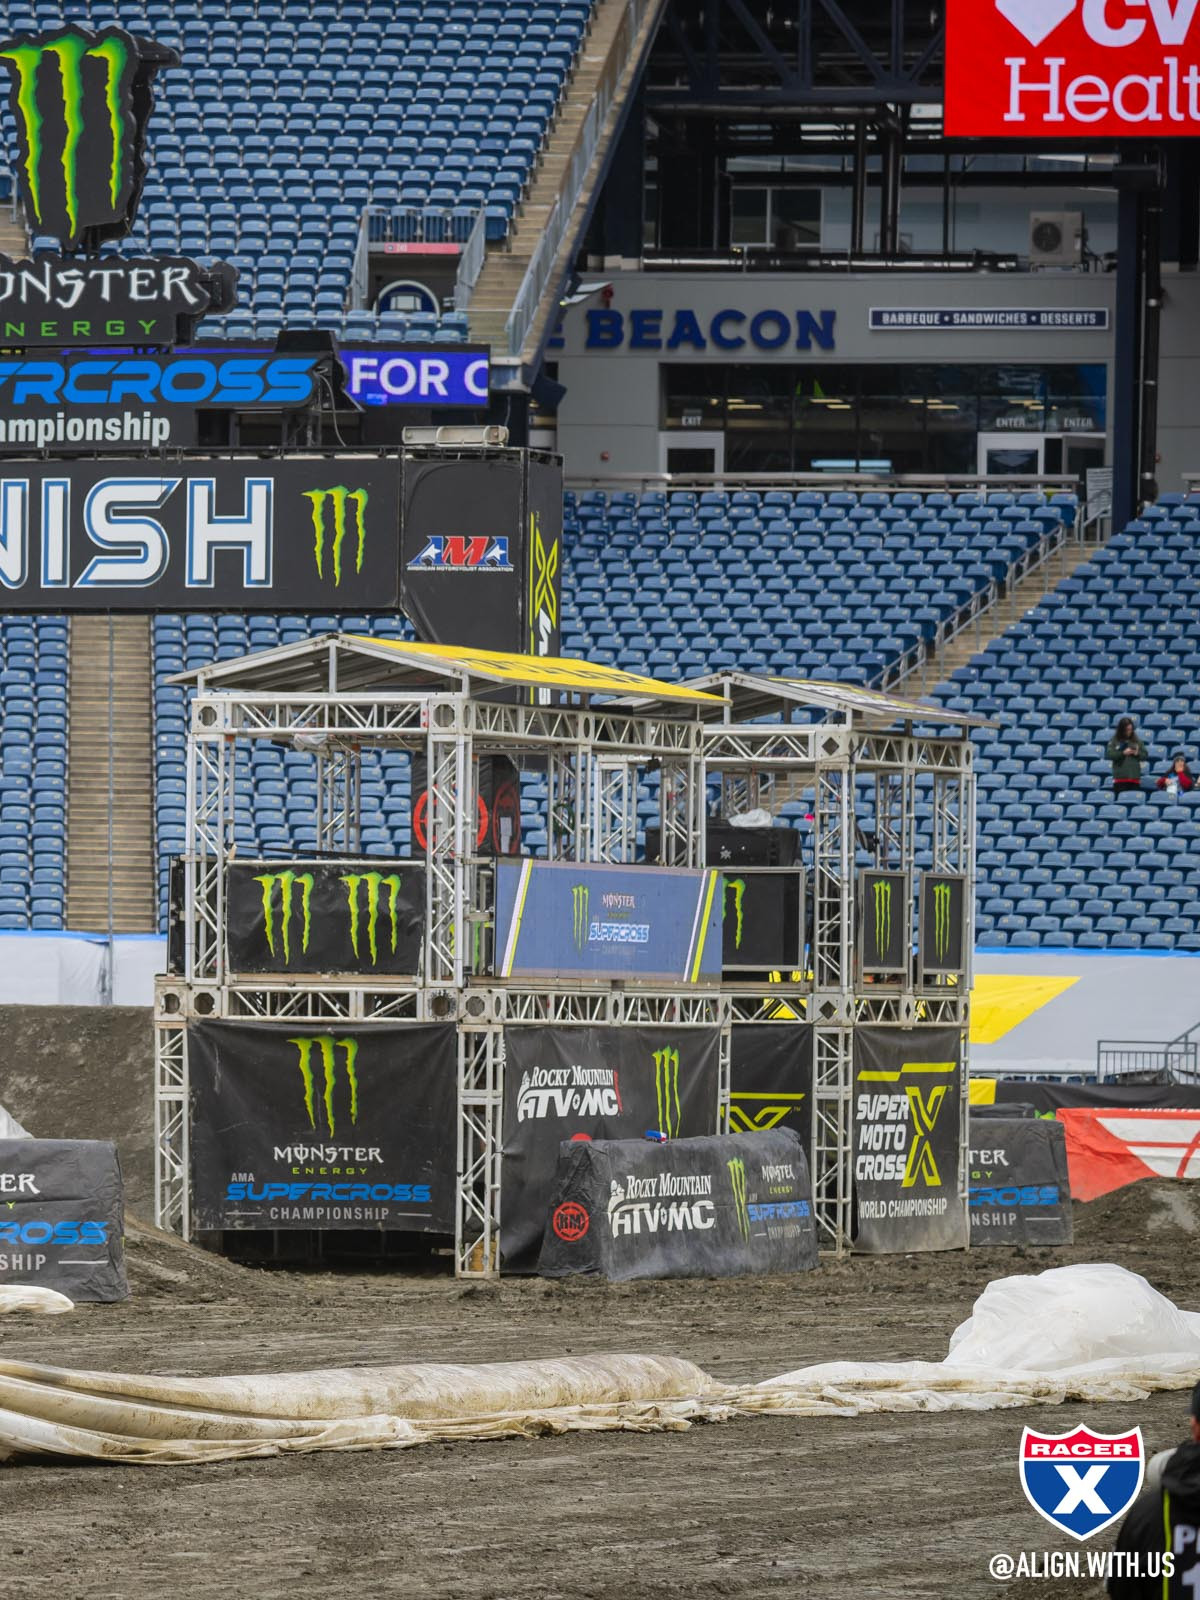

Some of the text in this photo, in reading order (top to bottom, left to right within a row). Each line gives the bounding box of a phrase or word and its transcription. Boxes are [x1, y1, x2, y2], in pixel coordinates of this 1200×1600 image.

[882, 312, 1097, 325] BARBEQUE SANDWICHES DESSERTS
[585, 309, 837, 351] BEACON
[351, 357, 450, 396] FOR
[681, 415, 703, 427] EXIT
[995, 417, 1026, 428] ENTER
[1063, 417, 1094, 428] ENTER
[406, 535, 515, 567] AMA
[530, 1065, 614, 1087] ROCKY MOUNTAIN
[856, 1094, 909, 1120] SUPER
[859, 1124, 907, 1151] MOTO
[273, 1144, 385, 1165] MONSTER
[231, 1172, 255, 1183] AMA
[292, 1167, 368, 1175] ENERGY
[856, 1155, 907, 1181] CROSS
[224, 1183, 432, 1203] SUPERCROSS
[626, 1172, 712, 1199] ROCKY MOUNTAIN
[269, 1207, 390, 1221] CHAMPIONSHIP
[859, 1198, 948, 1219] WORLD CHAMPIONSHIP
